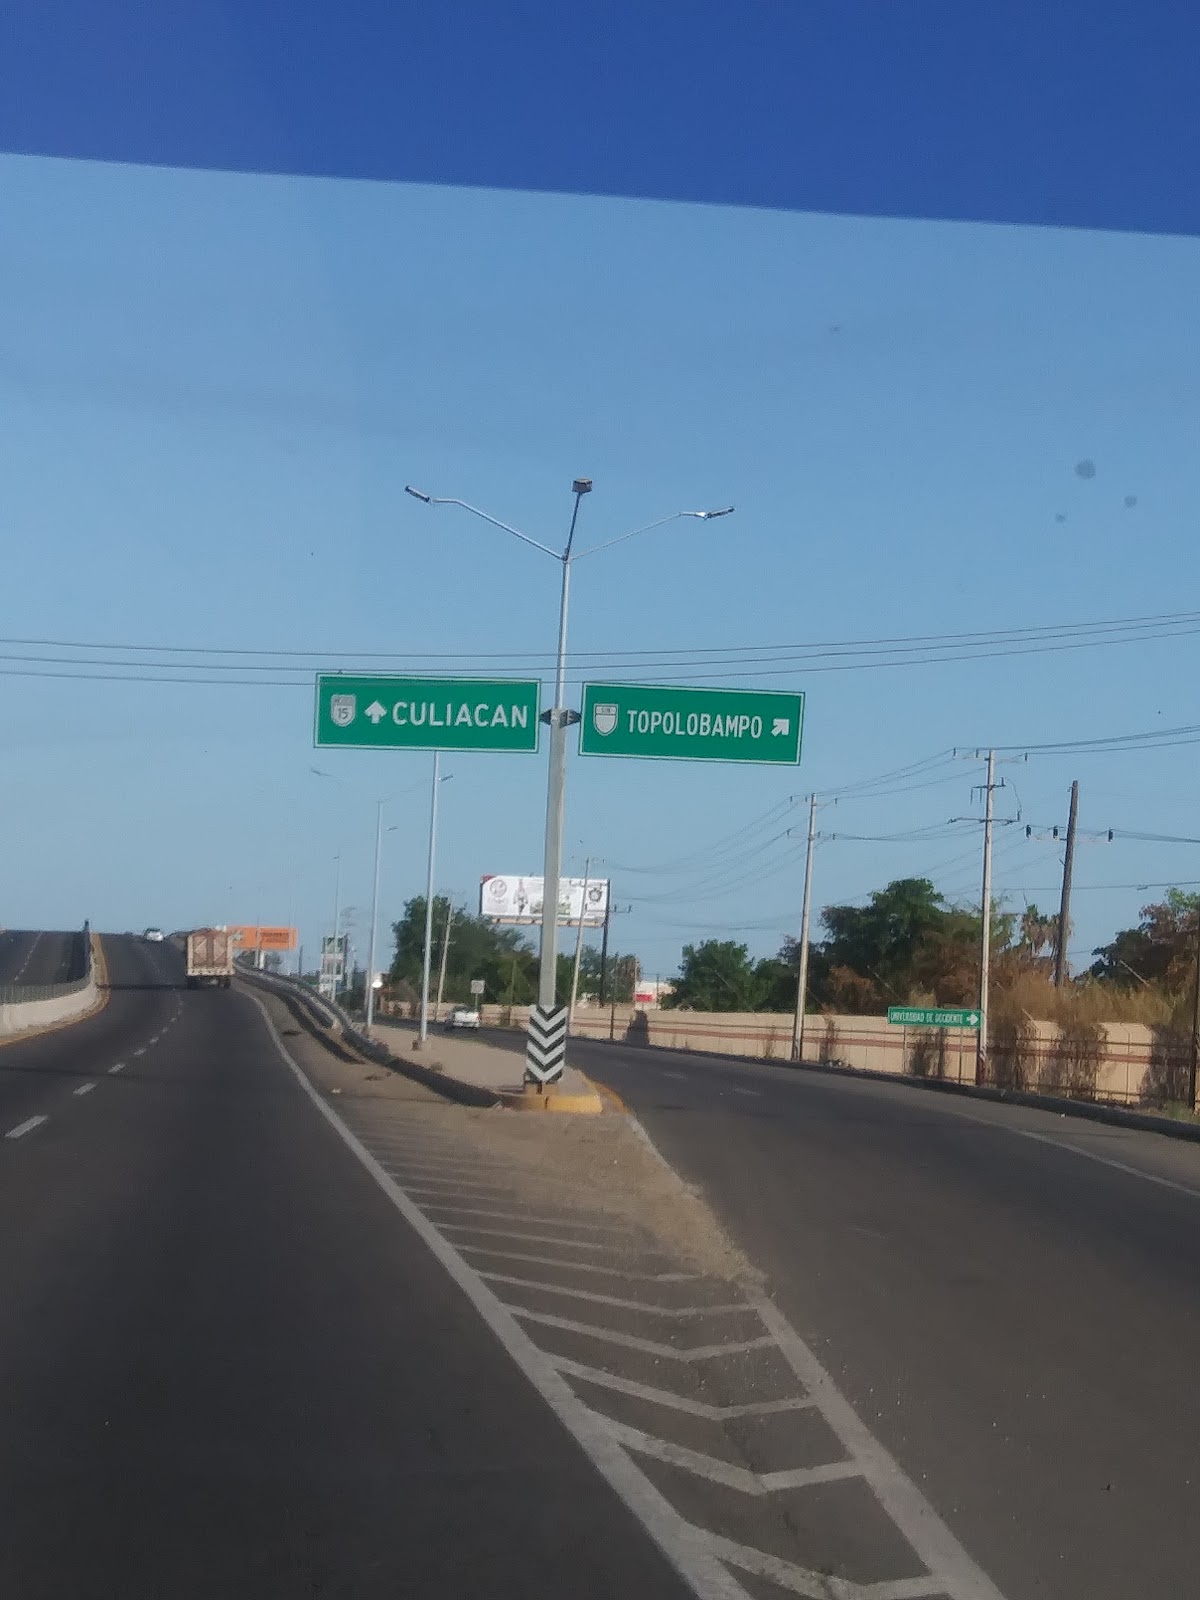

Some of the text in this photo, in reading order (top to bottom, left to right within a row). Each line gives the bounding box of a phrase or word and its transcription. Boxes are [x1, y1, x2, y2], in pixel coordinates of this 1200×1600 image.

[338, 707, 349, 720] 15
[392, 701, 528, 728] CULIACAN
[627, 709, 763, 739] TOPOLOBAMPO
